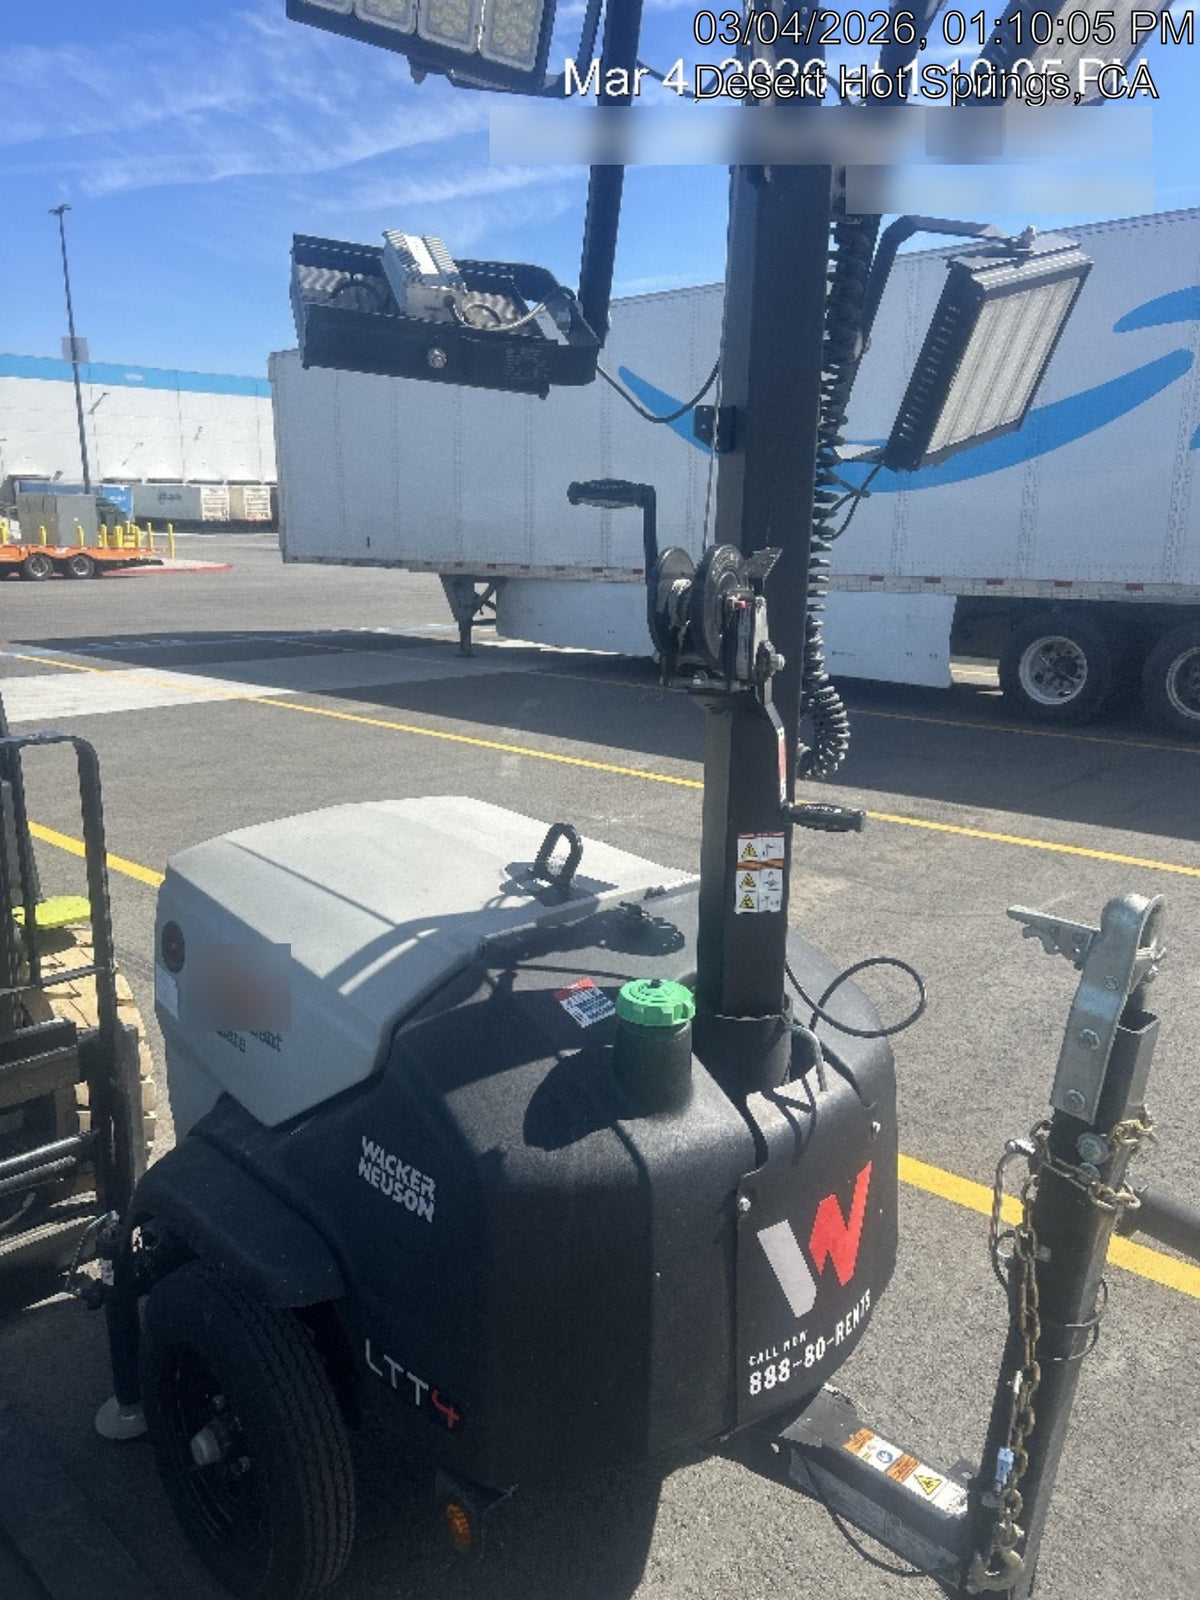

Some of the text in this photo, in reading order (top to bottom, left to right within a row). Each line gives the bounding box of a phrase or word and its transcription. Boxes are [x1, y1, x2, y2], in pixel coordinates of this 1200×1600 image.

[358, 1156, 434, 1223] NEUSON
[362, 1135, 436, 1203] WACKER
[748, 1346, 780, 1367] CALL
